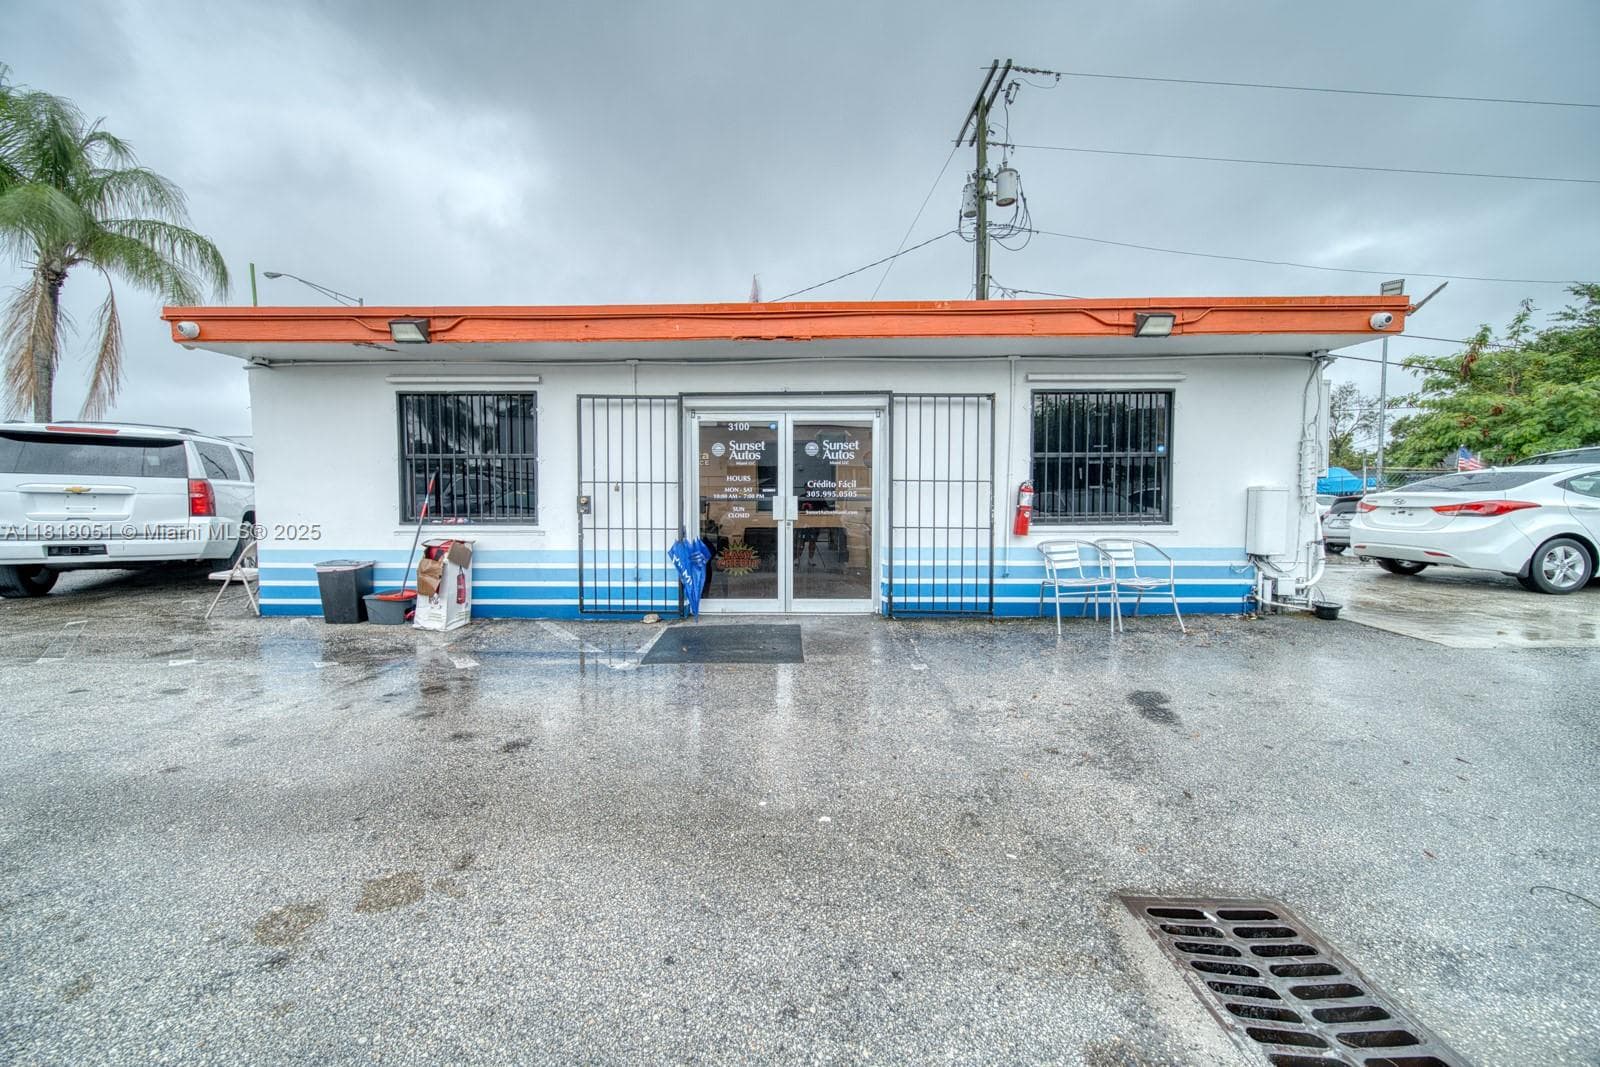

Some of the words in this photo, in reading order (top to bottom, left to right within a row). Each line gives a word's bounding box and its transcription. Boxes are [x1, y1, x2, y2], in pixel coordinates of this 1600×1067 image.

[728, 422, 750, 431] 3100
[729, 440, 766, 451] Sunset
[822, 440, 859, 450] Sunset
[729, 451, 761, 460] Autos
[822, 450, 855, 460] Autos
[807, 480, 837, 488] Crédito
[838, 480, 857, 488] Fácil
